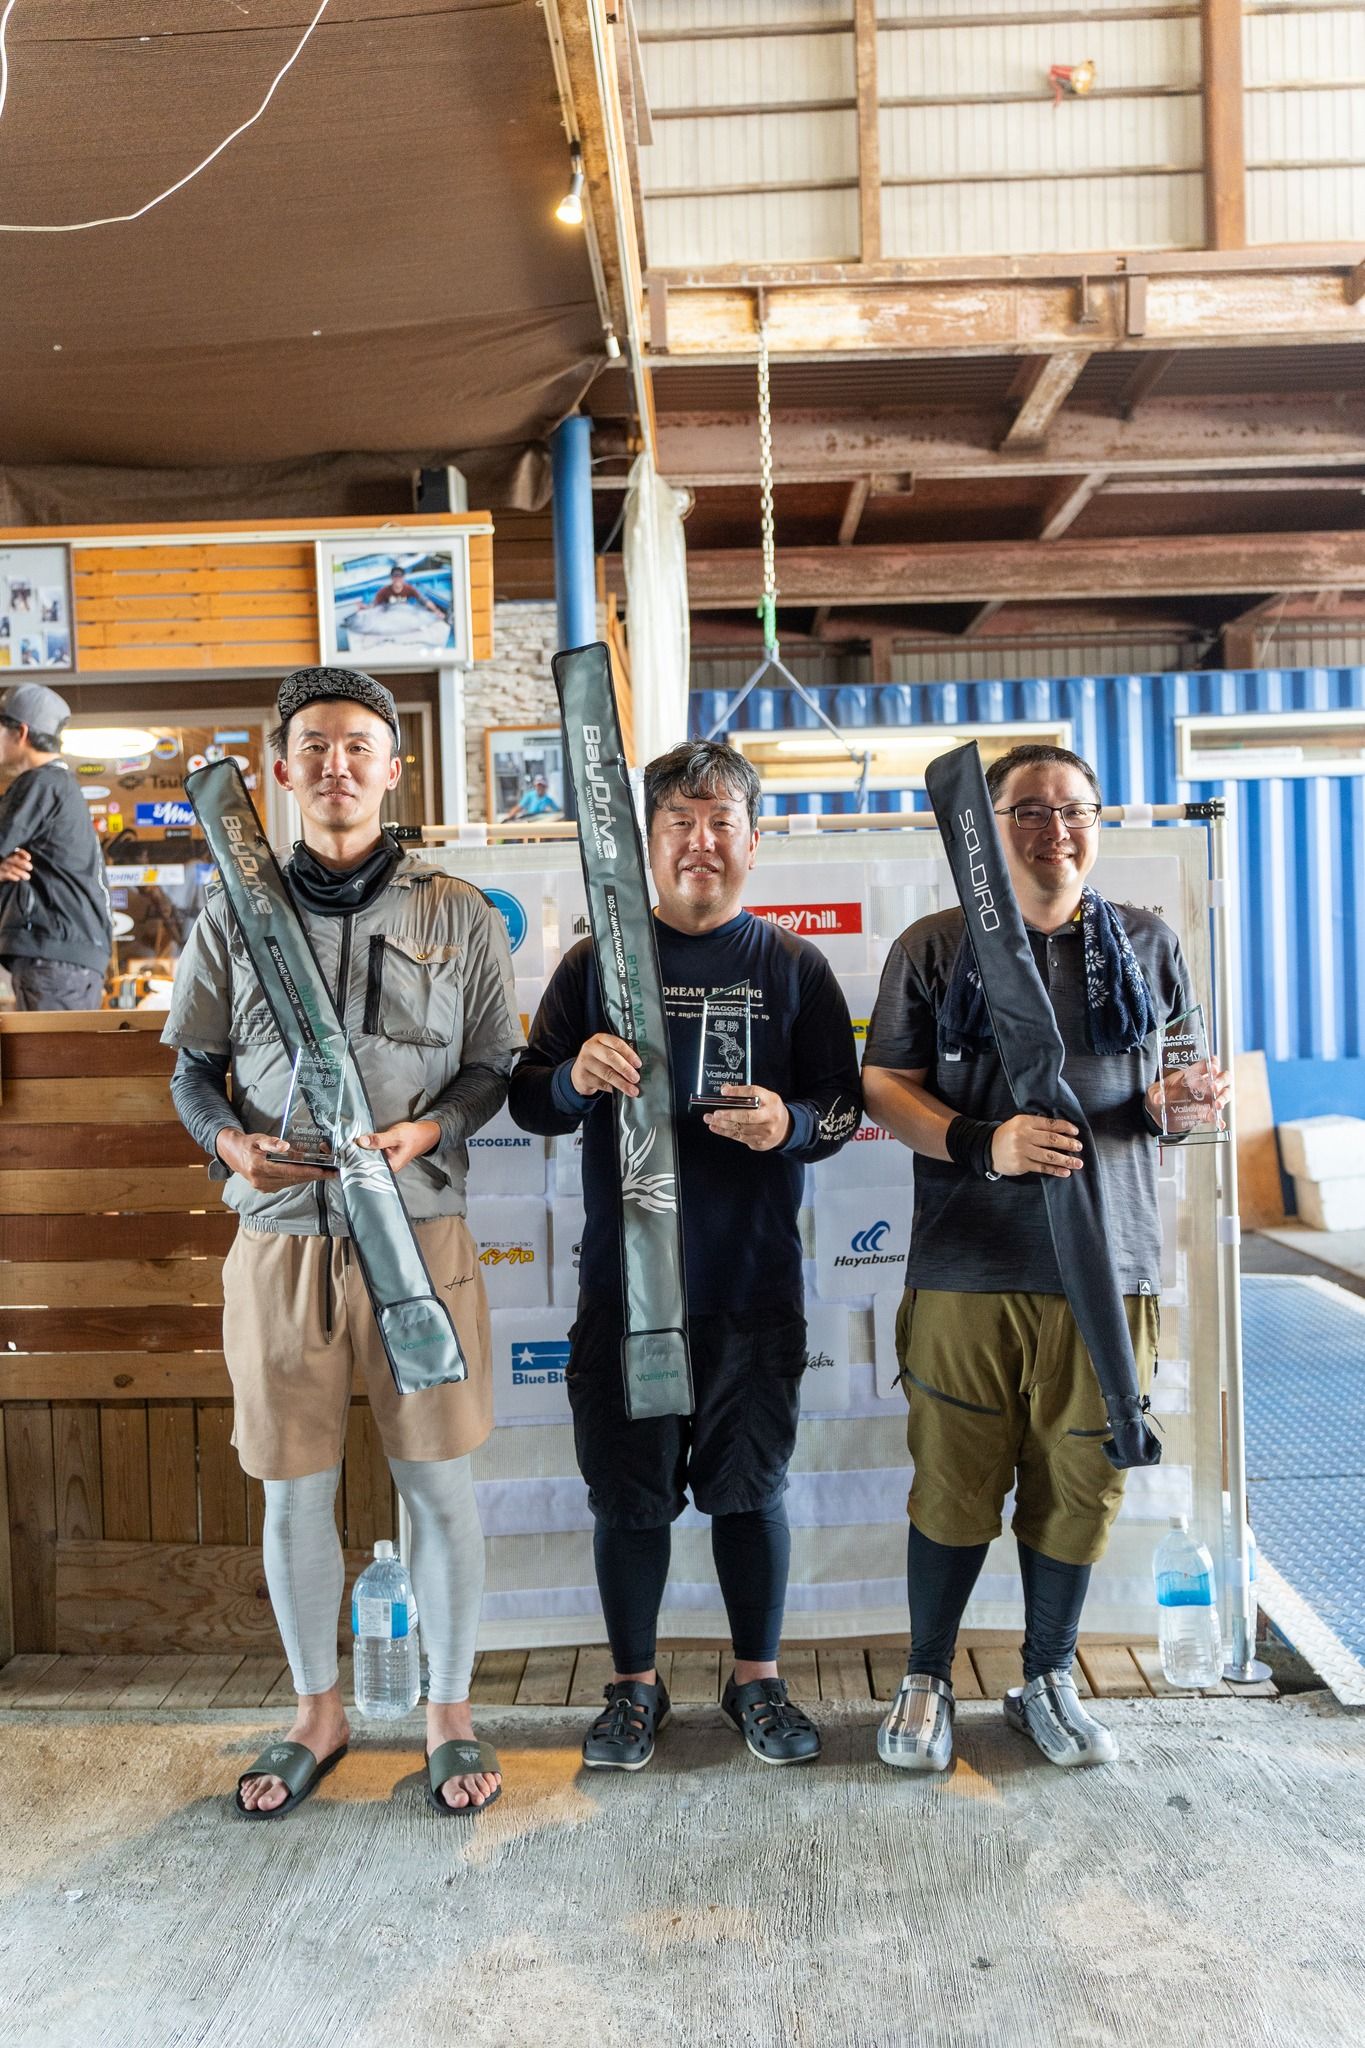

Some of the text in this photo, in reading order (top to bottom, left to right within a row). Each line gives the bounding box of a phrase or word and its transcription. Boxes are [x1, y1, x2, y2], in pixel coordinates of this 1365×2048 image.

[582, 725, 618, 859] BayDrive
[585, 785, 595, 822] SALTWATER
[592, 822, 600, 838] BOAT
[221, 815, 273, 915] BayDrive
[958, 809, 1000, 932] SOLDIRO
[627, 954, 642, 1000] BOAT
[663, 986, 705, 997] DREAM
[714, 1020, 740, 1032] 優勝
[1167, 1050, 1200, 1064] 第3位
[468, 1138, 532, 1147] ECOGEAR
[479, 1247, 534, 1265] イシグロ
[834, 1254, 905, 1267] Hayabusa
